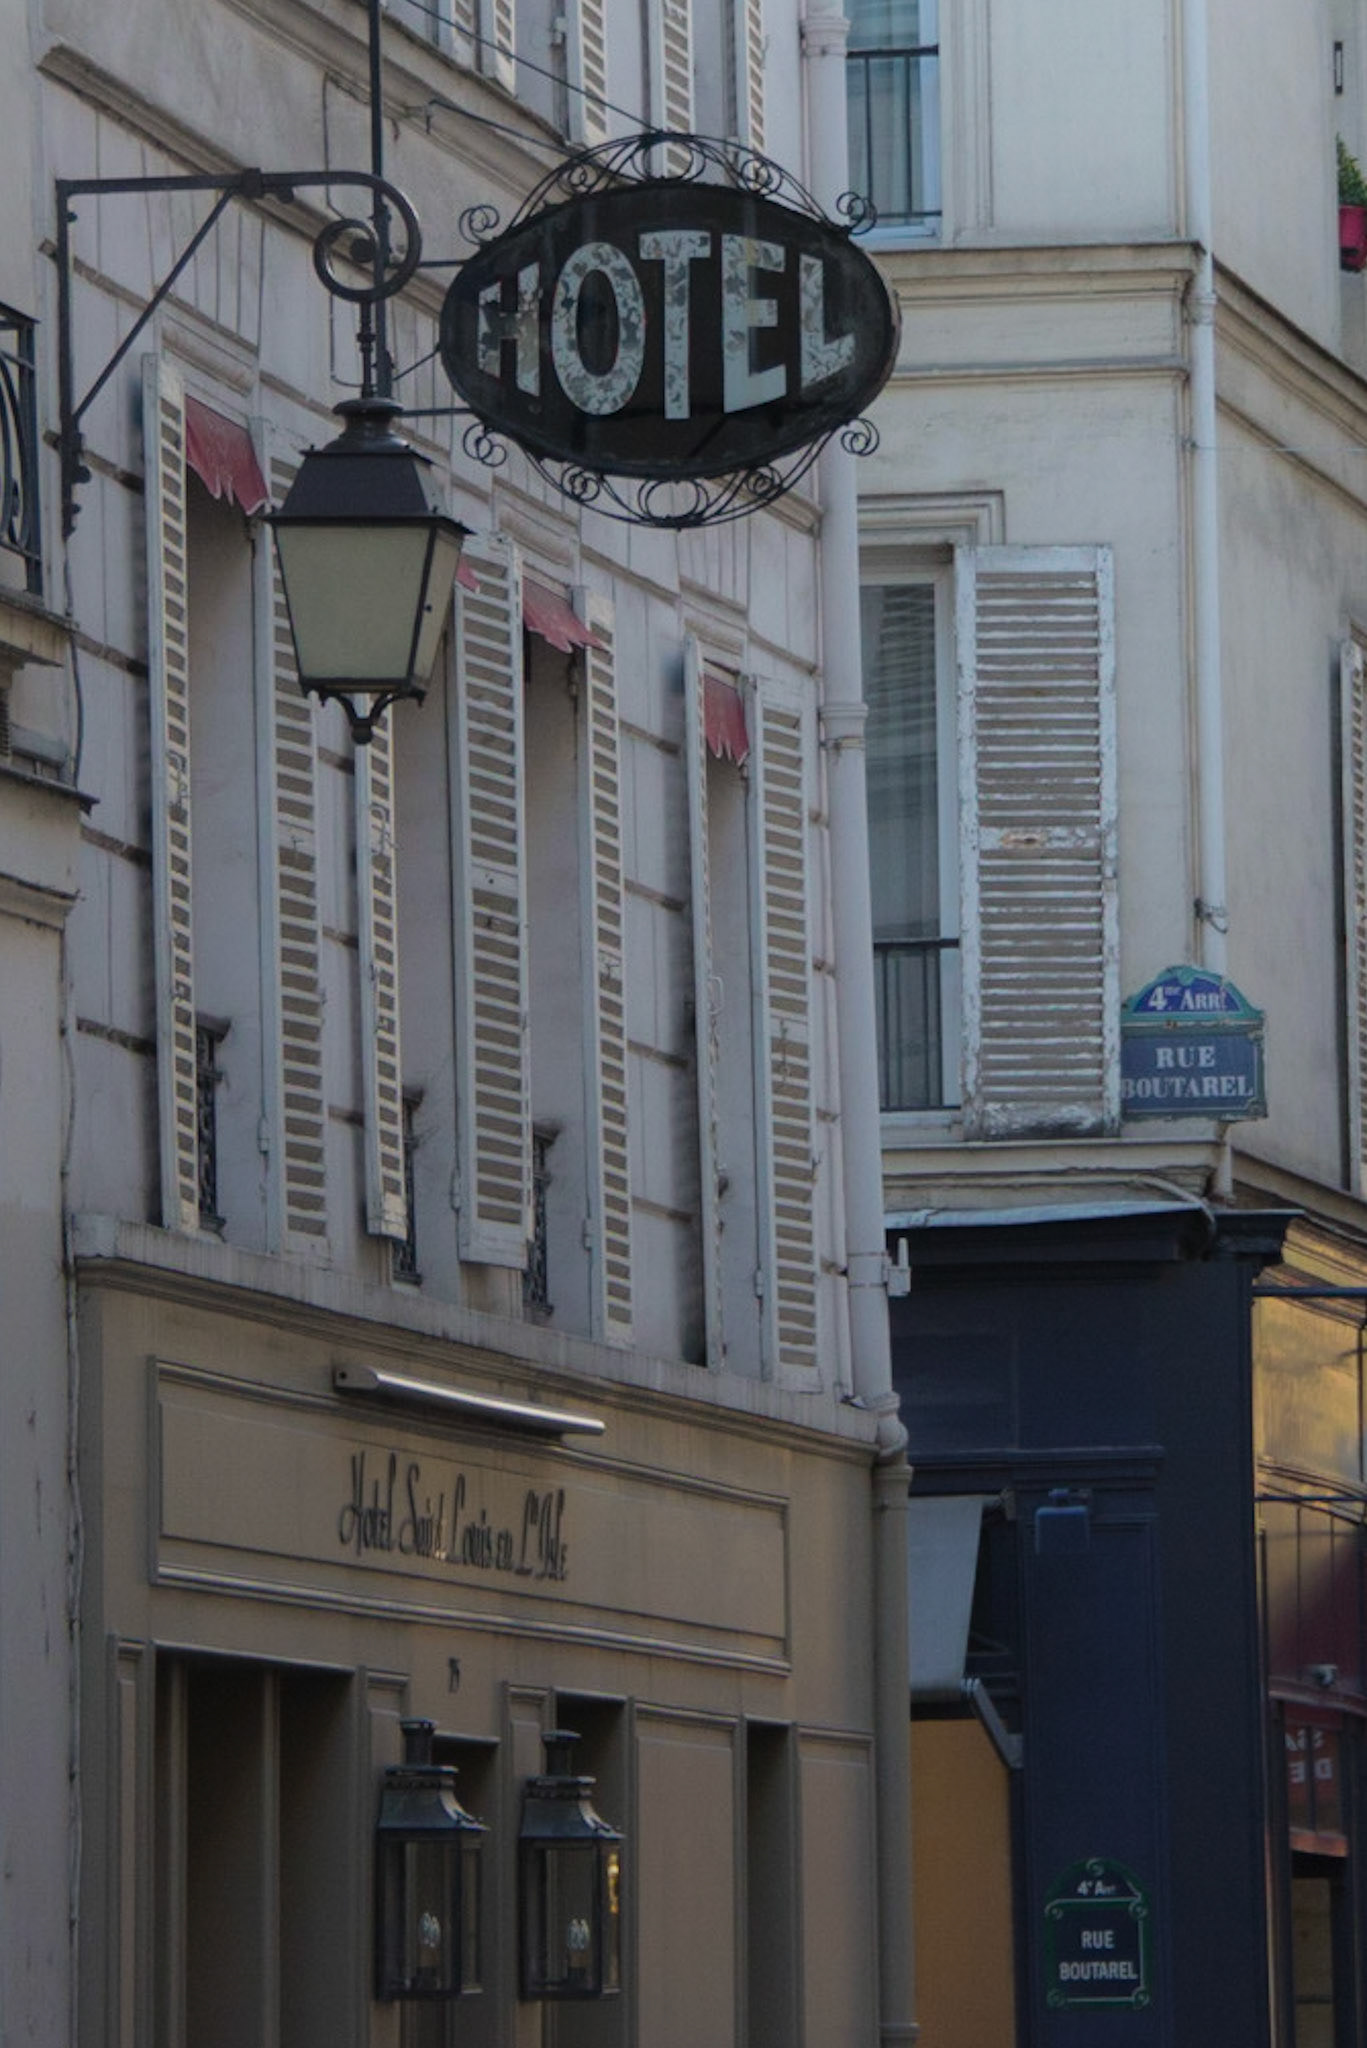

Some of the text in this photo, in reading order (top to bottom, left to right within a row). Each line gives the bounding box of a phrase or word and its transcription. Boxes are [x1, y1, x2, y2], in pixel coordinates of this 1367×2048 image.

[477, 229, 856, 420] HOTEL
[1155, 1045, 1216, 1069] RUE
[1121, 1075, 1254, 1099] BOUTAREL
[339, 1451, 397, 1557] Hotel
[1080, 1929, 1115, 1950] RUE
[1058, 1960, 1138, 1981] BOUTAREL
